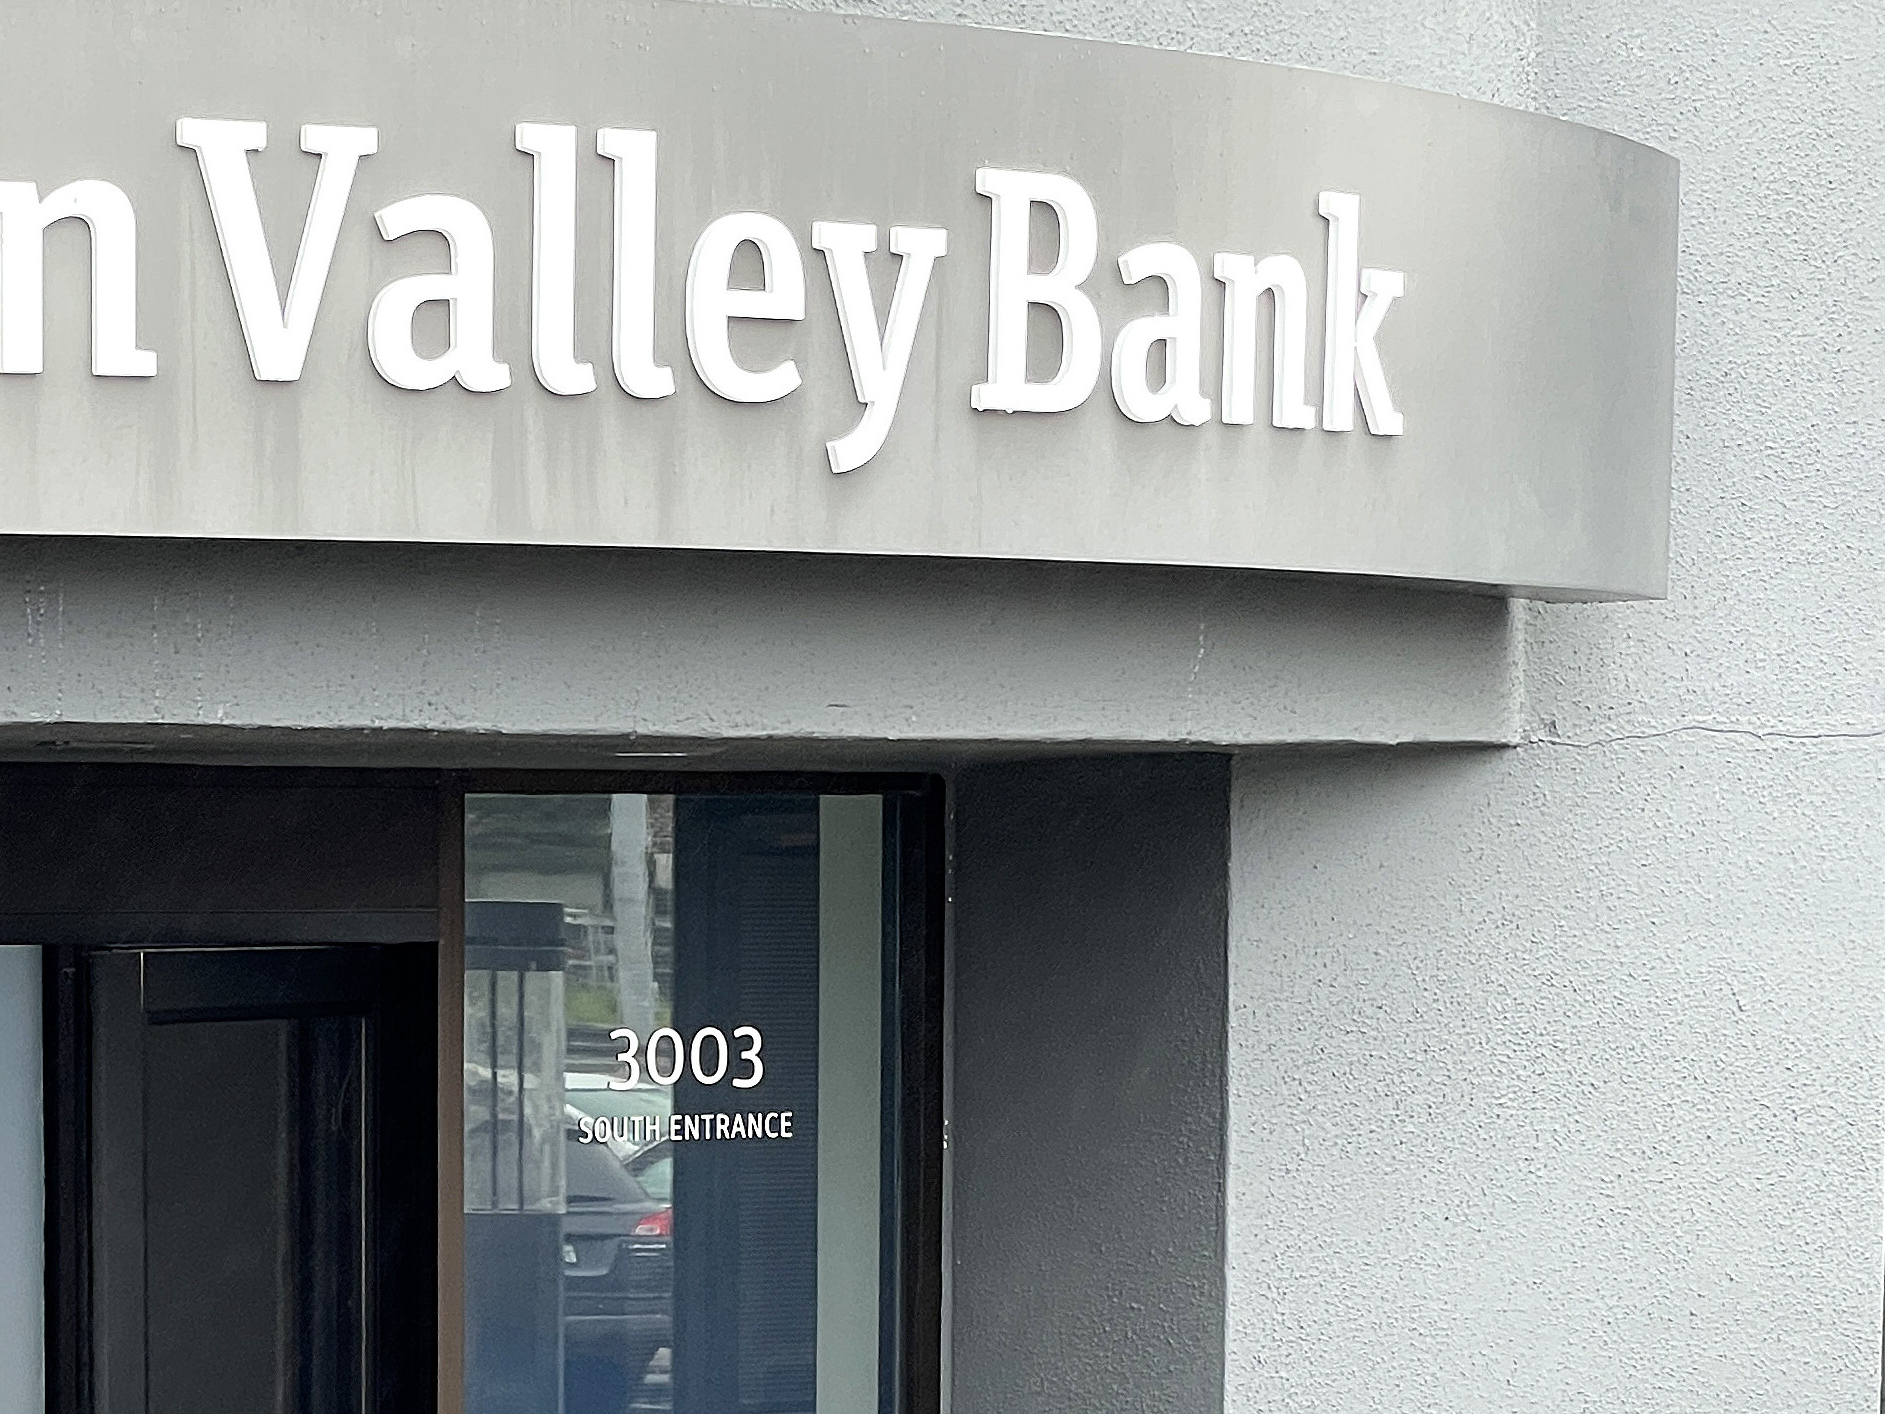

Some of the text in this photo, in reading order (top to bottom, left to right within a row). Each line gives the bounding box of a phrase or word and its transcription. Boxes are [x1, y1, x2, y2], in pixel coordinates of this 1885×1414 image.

[175, 117, 948, 474] Valley
[970, 167, 1406, 436] Bank
[608, 1025, 765, 1091] 3003
[577, 1111, 794, 1144] SOUTH ENTRANCE
